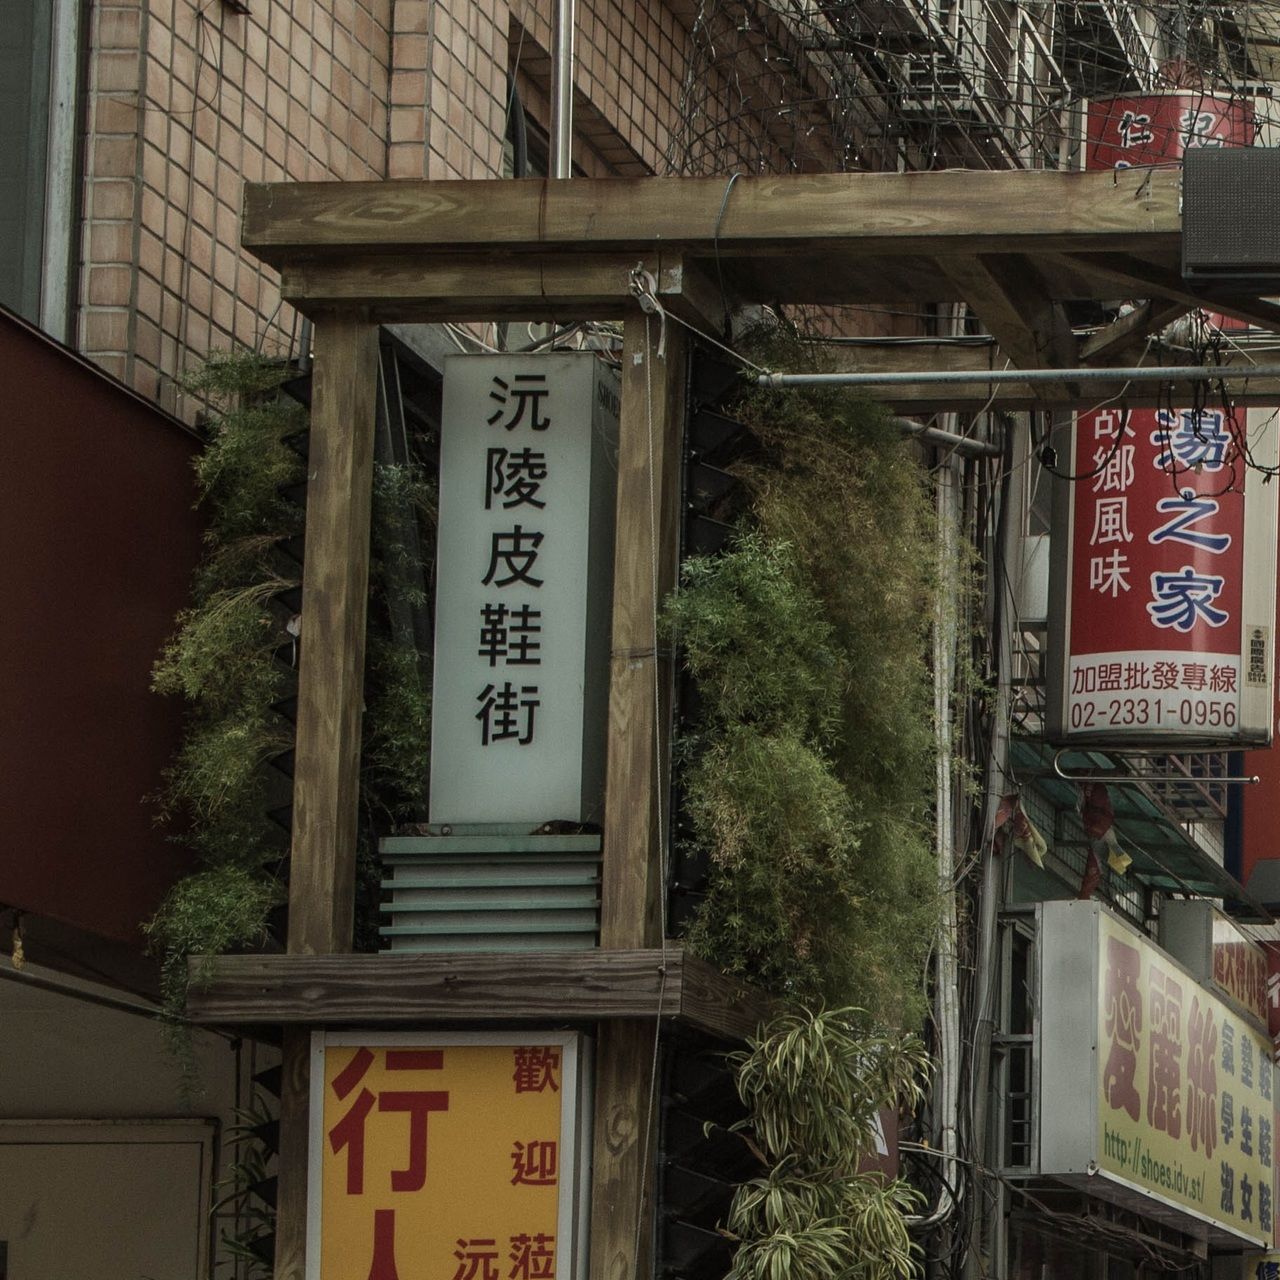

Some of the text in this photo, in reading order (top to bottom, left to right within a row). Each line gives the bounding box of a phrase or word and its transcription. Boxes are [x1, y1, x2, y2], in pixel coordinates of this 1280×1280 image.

[473, 373, 551, 747] 沅陵皮鞋街
[1071, 661, 1238, 695] 加盟批發專線
[1071, 699, 1237, 729] 02-2331-0956
